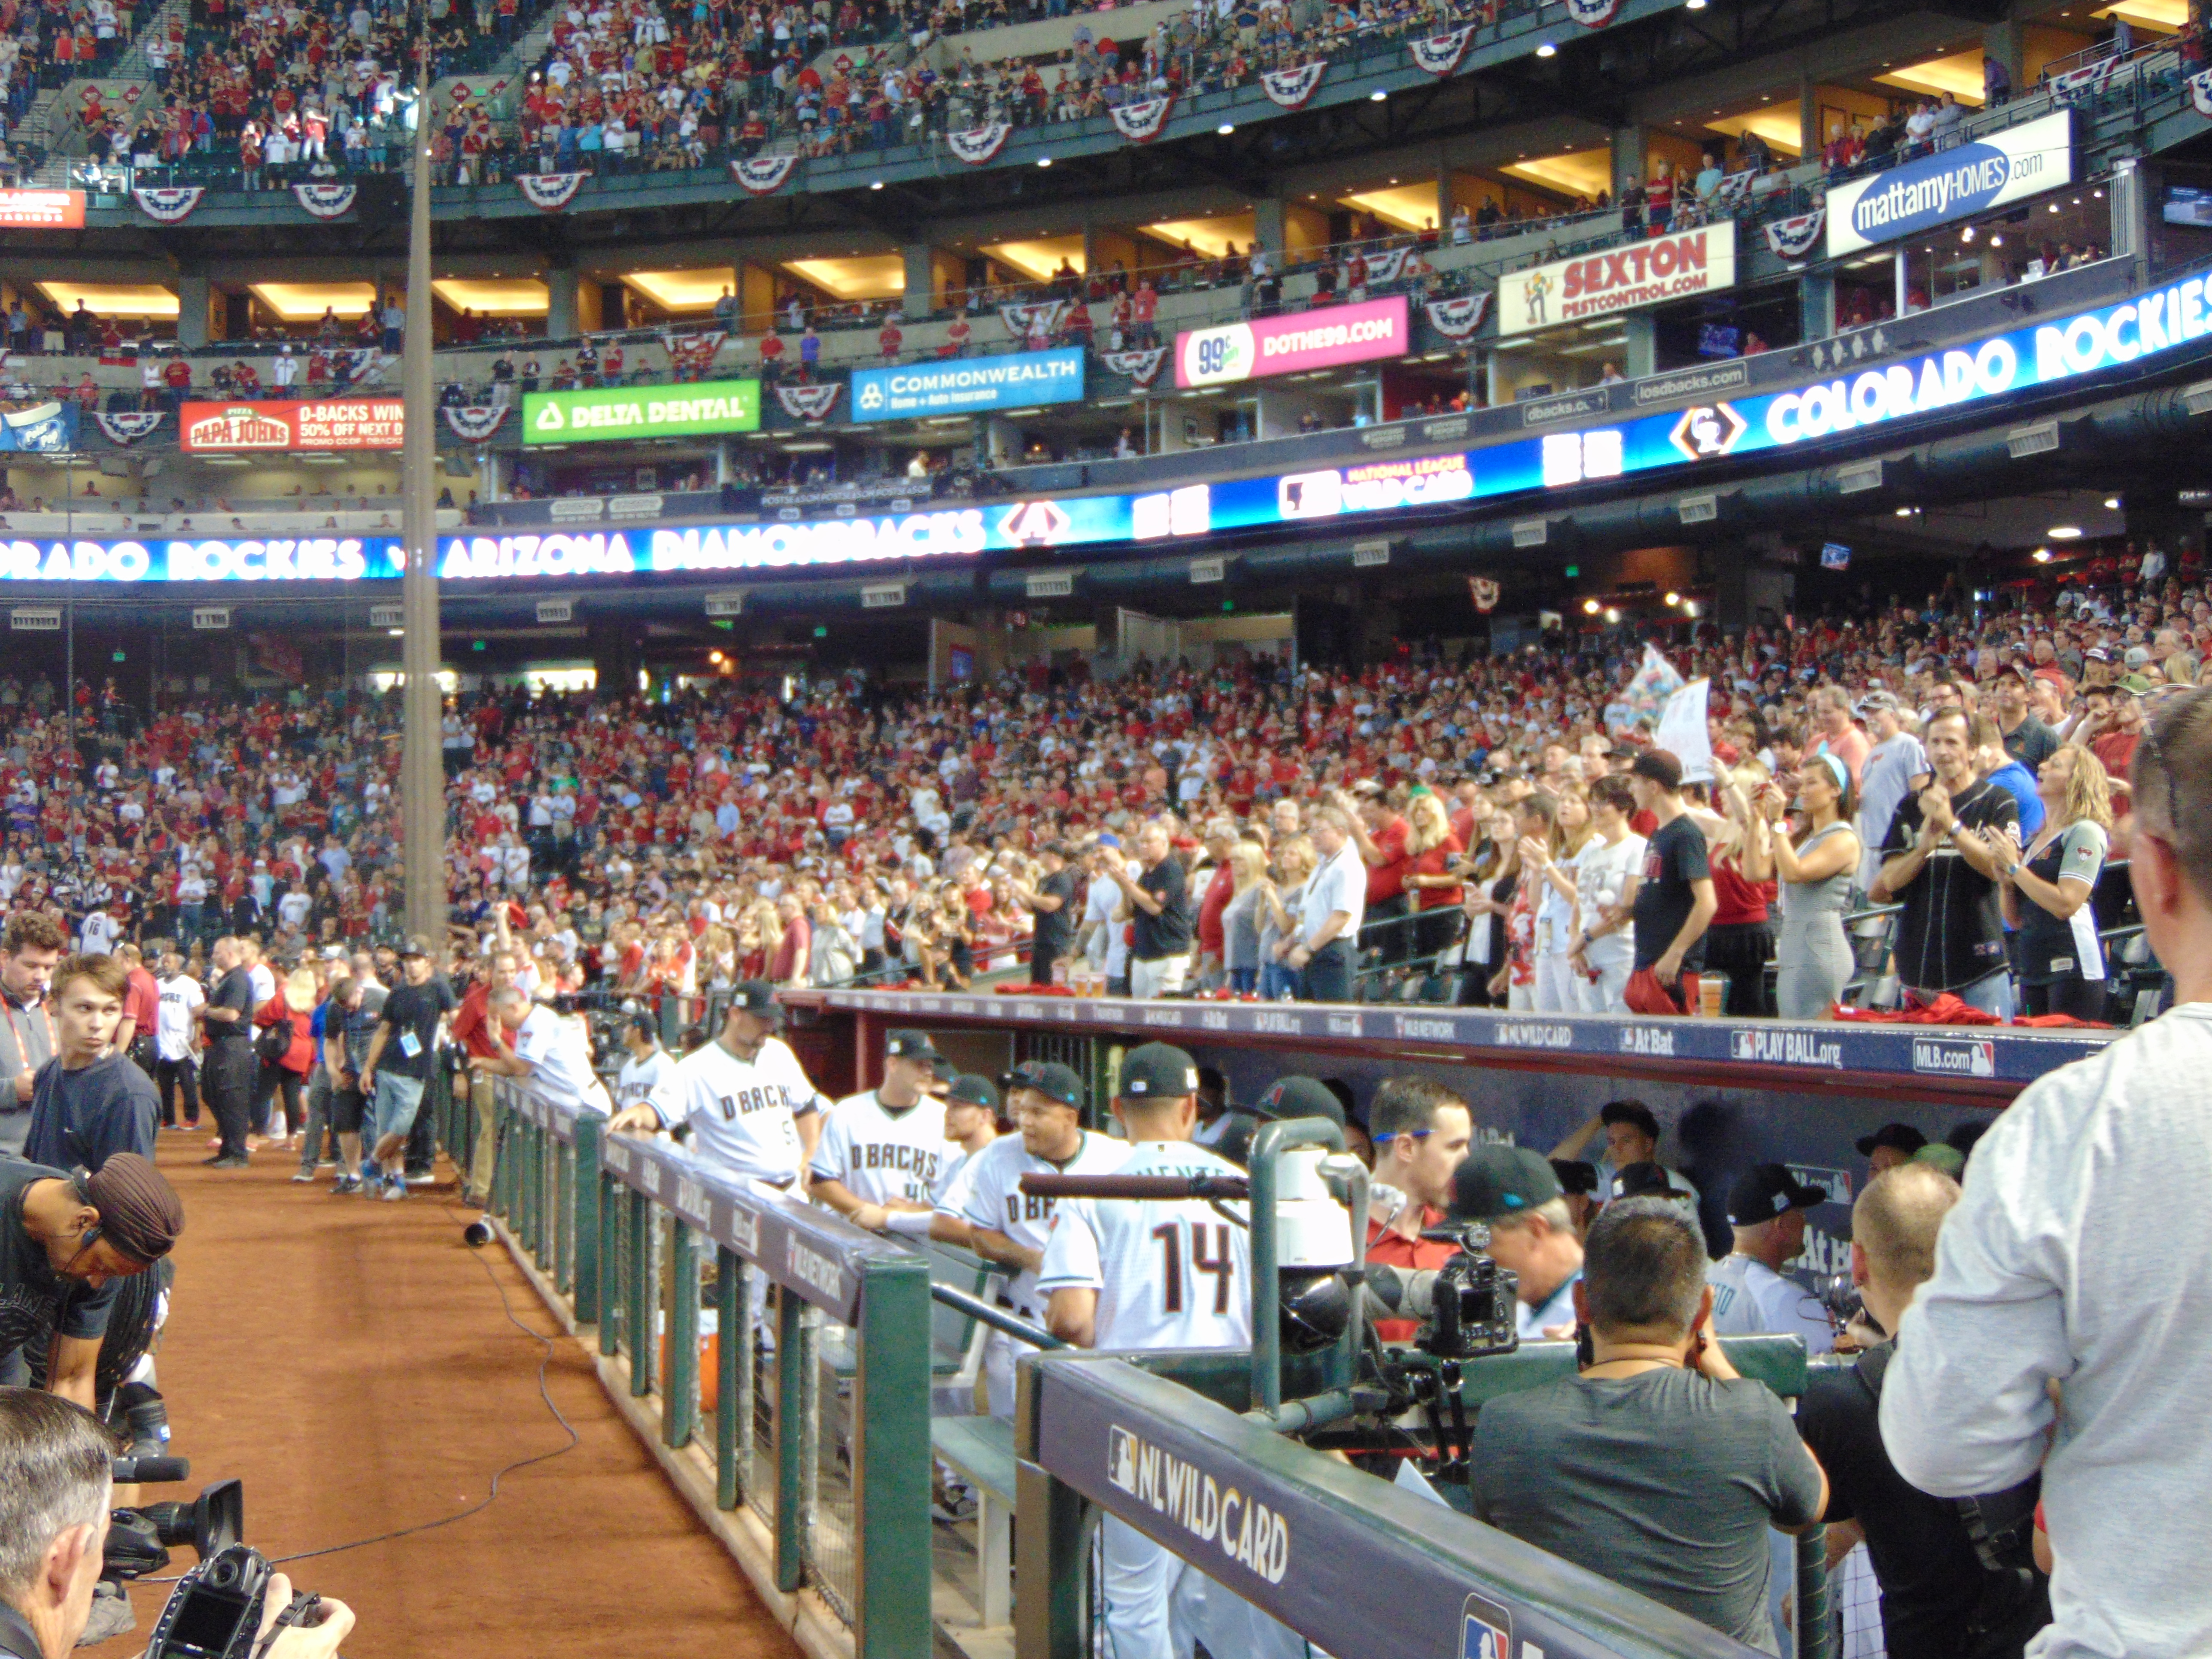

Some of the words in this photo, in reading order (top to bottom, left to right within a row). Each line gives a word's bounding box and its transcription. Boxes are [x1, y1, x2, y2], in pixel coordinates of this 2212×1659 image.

[1563, 233, 1707, 299] SEXTON
[1562, 273, 1708, 319] PESTCONTROL.COM
[1264, 318, 1393, 356] DOTHE99.COM
[890, 360, 1076, 394] COMMONWEALTH
[1640, 369, 1743, 399] losdbacks.com
[1766, 339, 2017, 445] COLORADO
[300, 406, 367, 422] D-BACKS
[571, 403, 643, 429] DELTA
[648, 397, 744, 423] DENTAL
[891, 397, 917, 409] Home
[951, 389, 997, 403] Insurance
[194, 420, 232, 444] PAPA
[300, 423, 330, 436] 50%
[334, 422, 354, 435] OFF
[359, 422, 390, 435] NEXT
[1348, 461, 1413, 482] NATIONAL
[1416, 454, 1465, 474] LEAGUE
[0, 541, 149, 580] RADO
[168, 539, 365, 580] ROCKIES
[442, 534, 635, 578] ARIZONA
[652, 508, 987, 571] DIAMONDBACKS
[1635, 1028, 1650, 1053] At
[1651, 1030, 1674, 1055] Bat
[1754, 1032, 1783, 1062] PLAY
[1787, 1032, 1842, 1069] BALL.org
[1916, 1044, 1970, 1070] MLB.com
[1152, 1221, 1234, 1316] 14
[1139, 1440, 1164, 1512] NL
[1165, 1453, 1219, 1541] WILD
[1221, 1488, 1288, 1584] CARD
